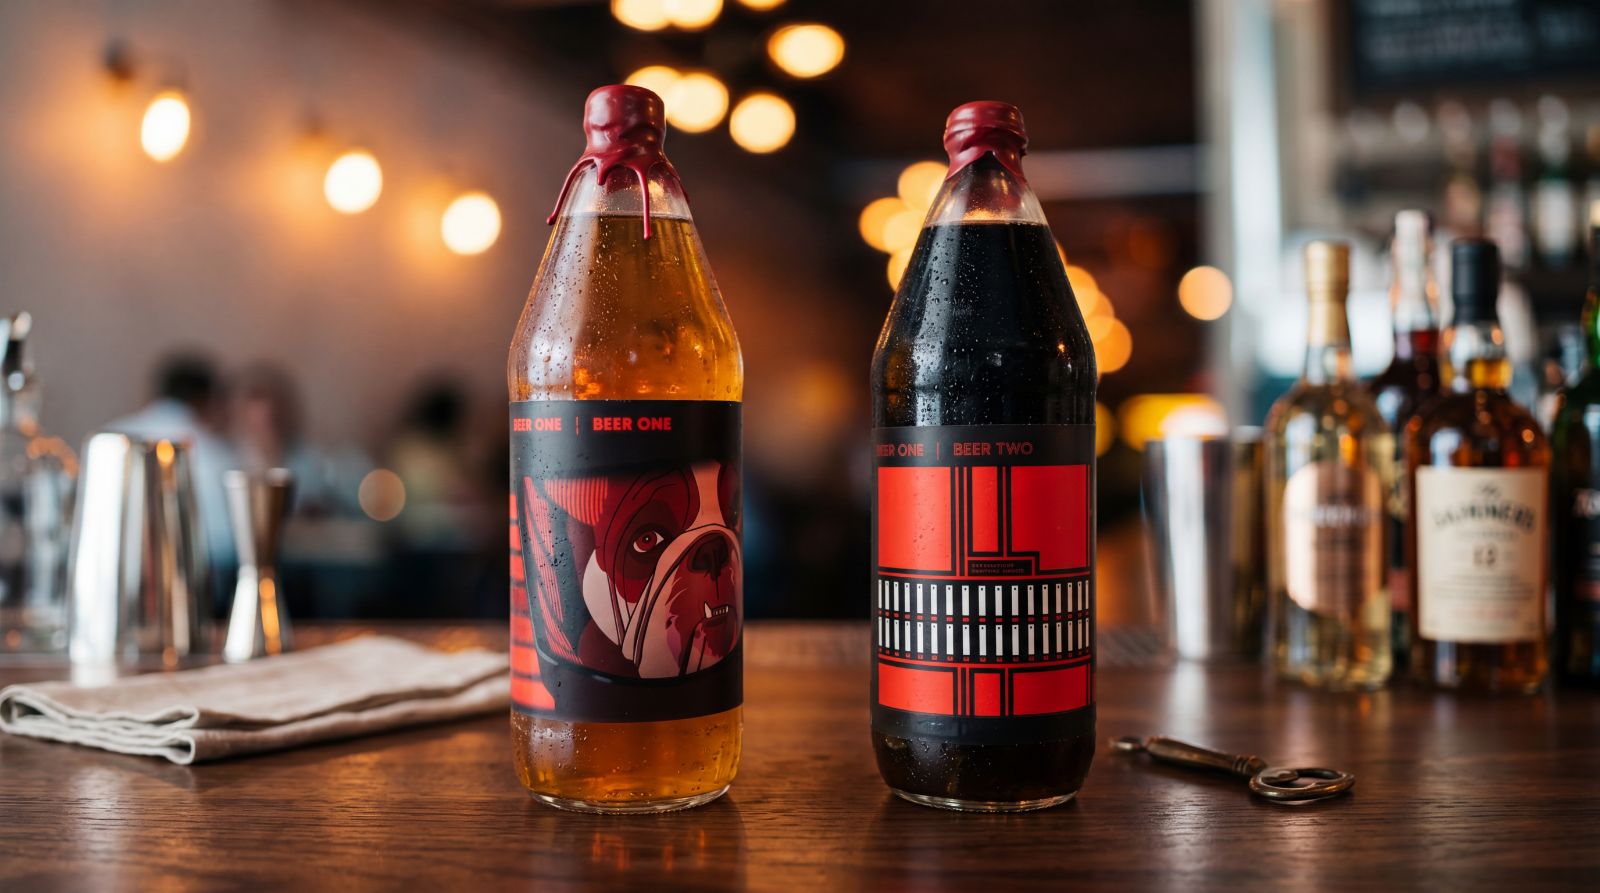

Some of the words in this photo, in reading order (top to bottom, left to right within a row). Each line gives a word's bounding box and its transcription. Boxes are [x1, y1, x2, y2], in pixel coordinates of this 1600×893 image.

[513, 418, 532, 431] BEER
[535, 417, 562, 431] ONE
[592, 417, 633, 431] BEER
[637, 417, 672, 431] ONE
[897, 443, 924, 457] ONE
[953, 442, 991, 456] BEER
[996, 441, 1034, 455] TWO
